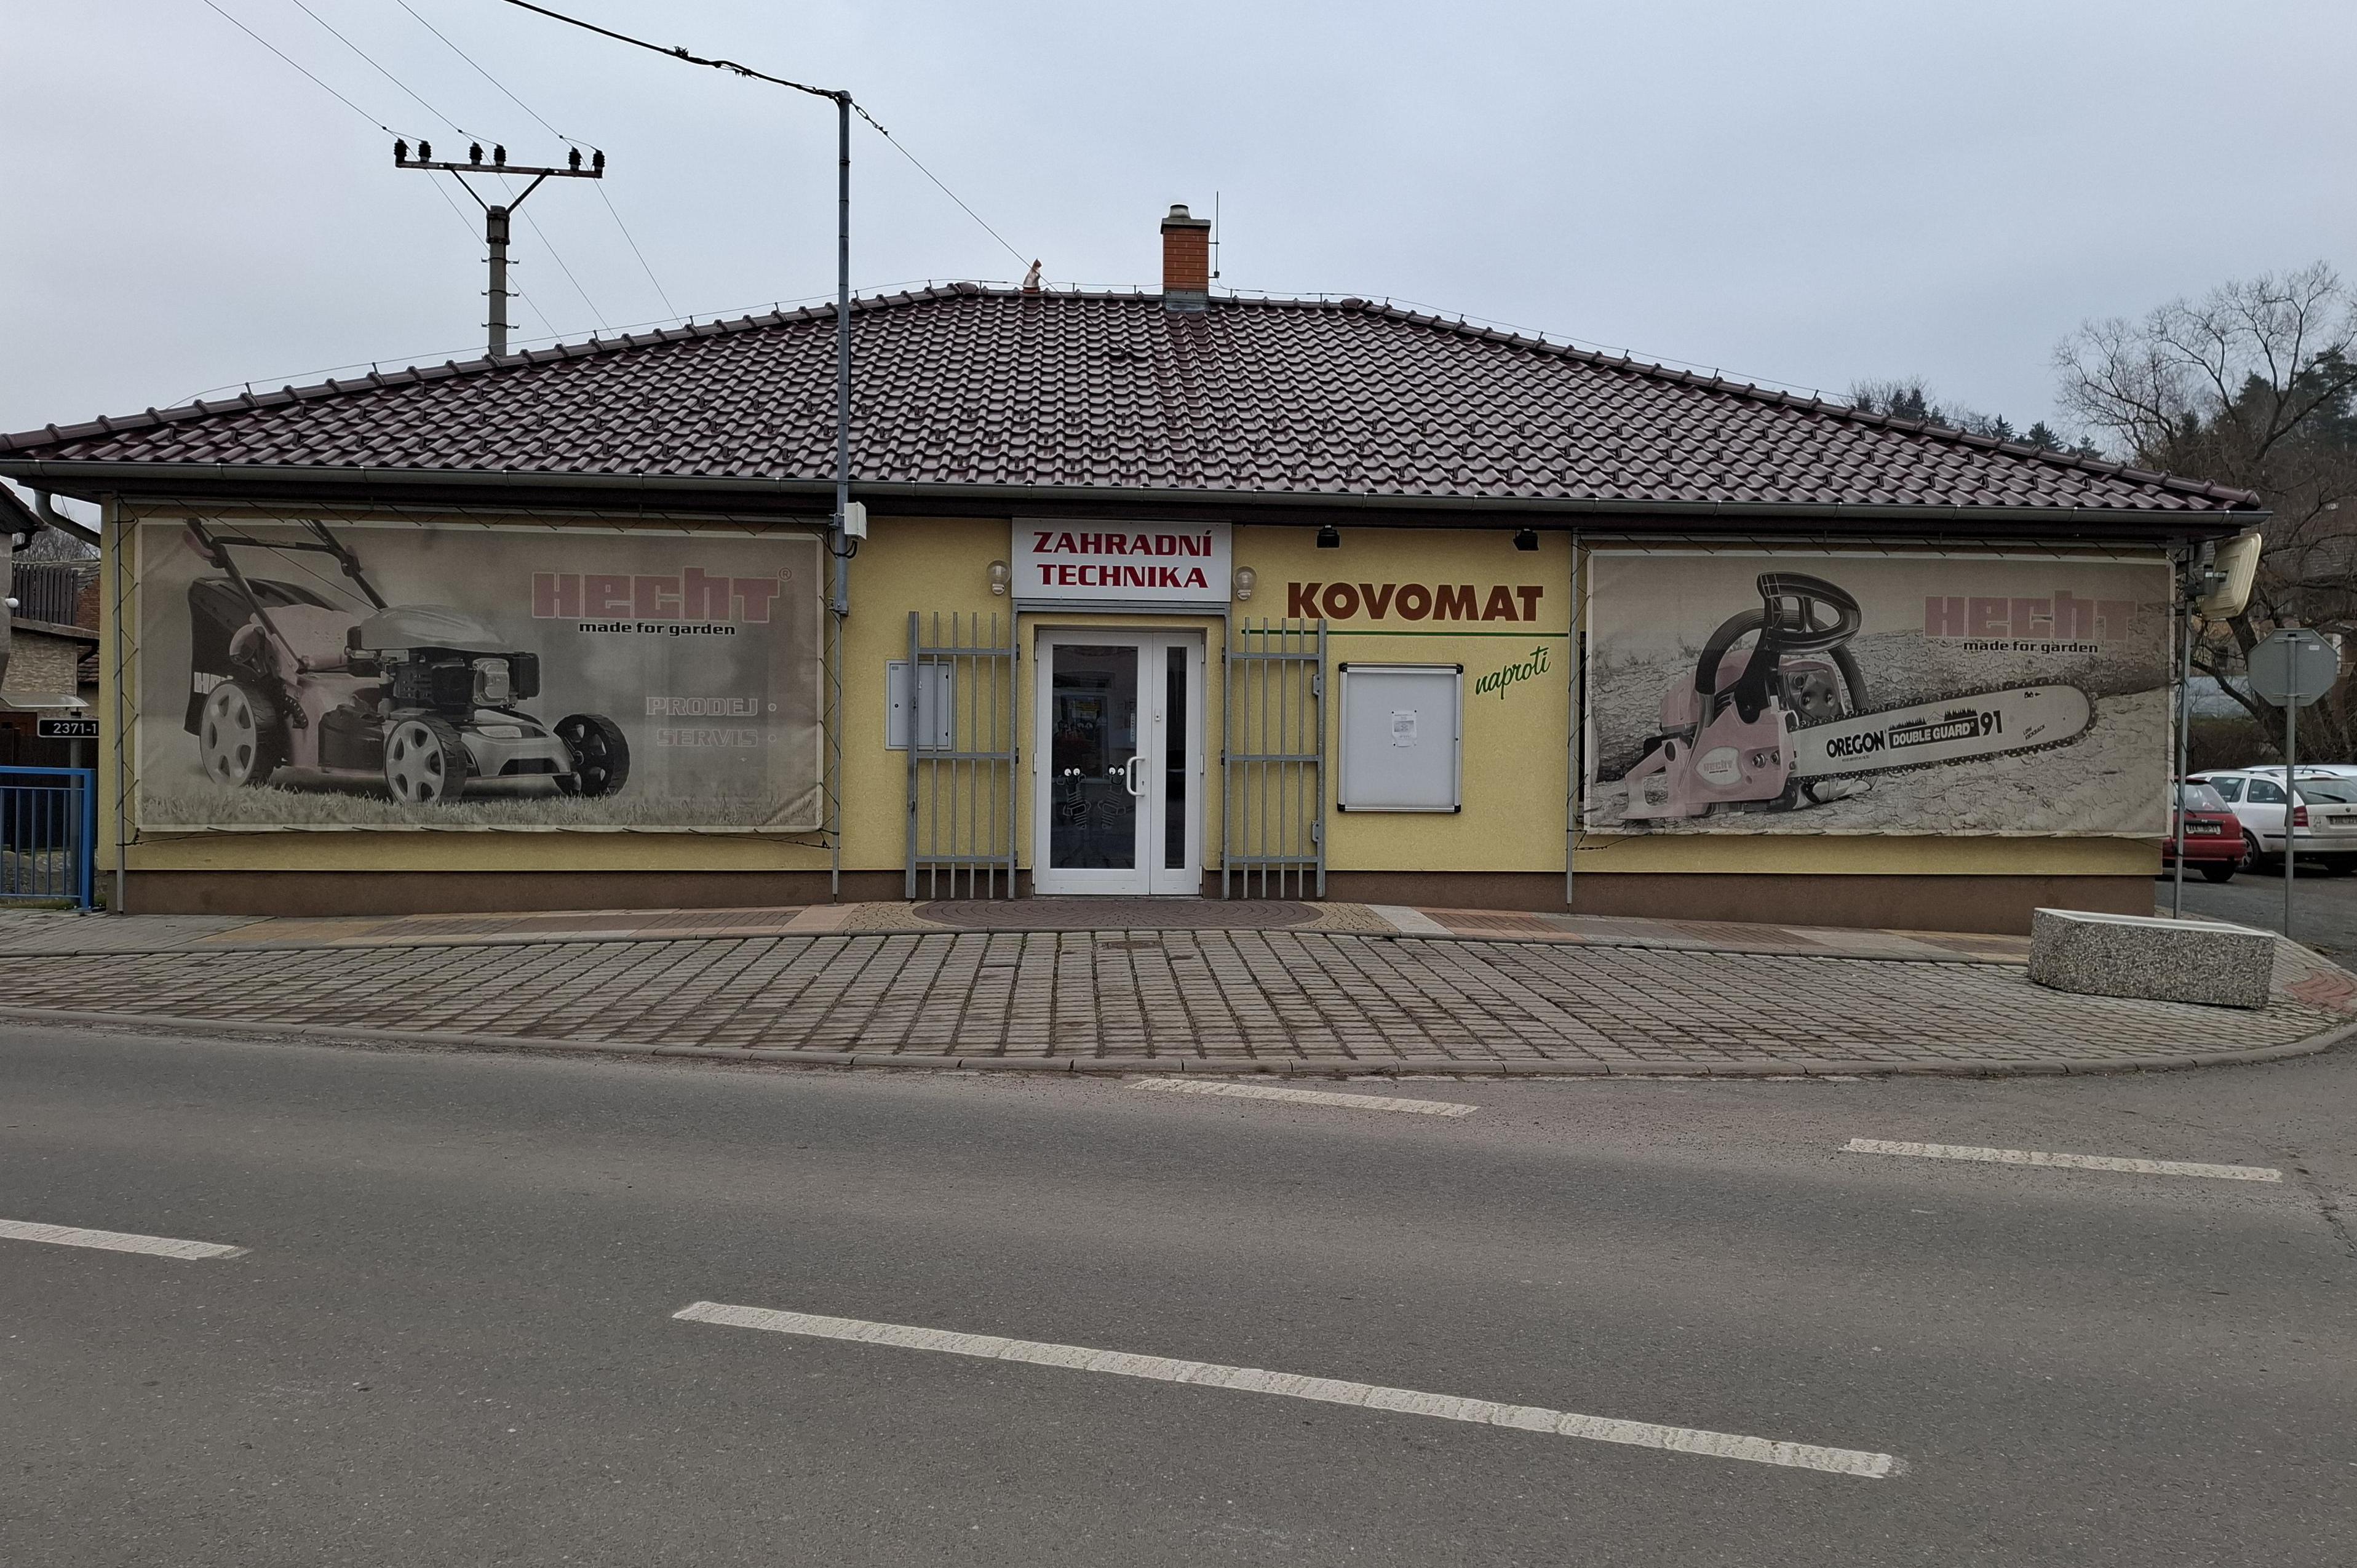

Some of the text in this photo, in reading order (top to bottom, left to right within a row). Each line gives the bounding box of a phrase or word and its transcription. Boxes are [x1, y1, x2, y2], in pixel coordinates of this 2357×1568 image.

[1033, 530, 1212, 557] ZAHRADNÍ
[1036, 564, 1209, 588] TECHNIKA
[1287, 582, 1544, 622] KOVOMAT
[579, 622, 736, 637] made for garden
[1963, 640, 2099, 655] made for garden
[1476, 646, 1551, 699] naproti
[646, 697, 758, 716] PRODEJ
[53, 723, 97, 734] 2371-1
[656, 728, 758, 748] SERVIS
[1826, 710, 2003, 758] OREGON DOUBLE GUARD 91
